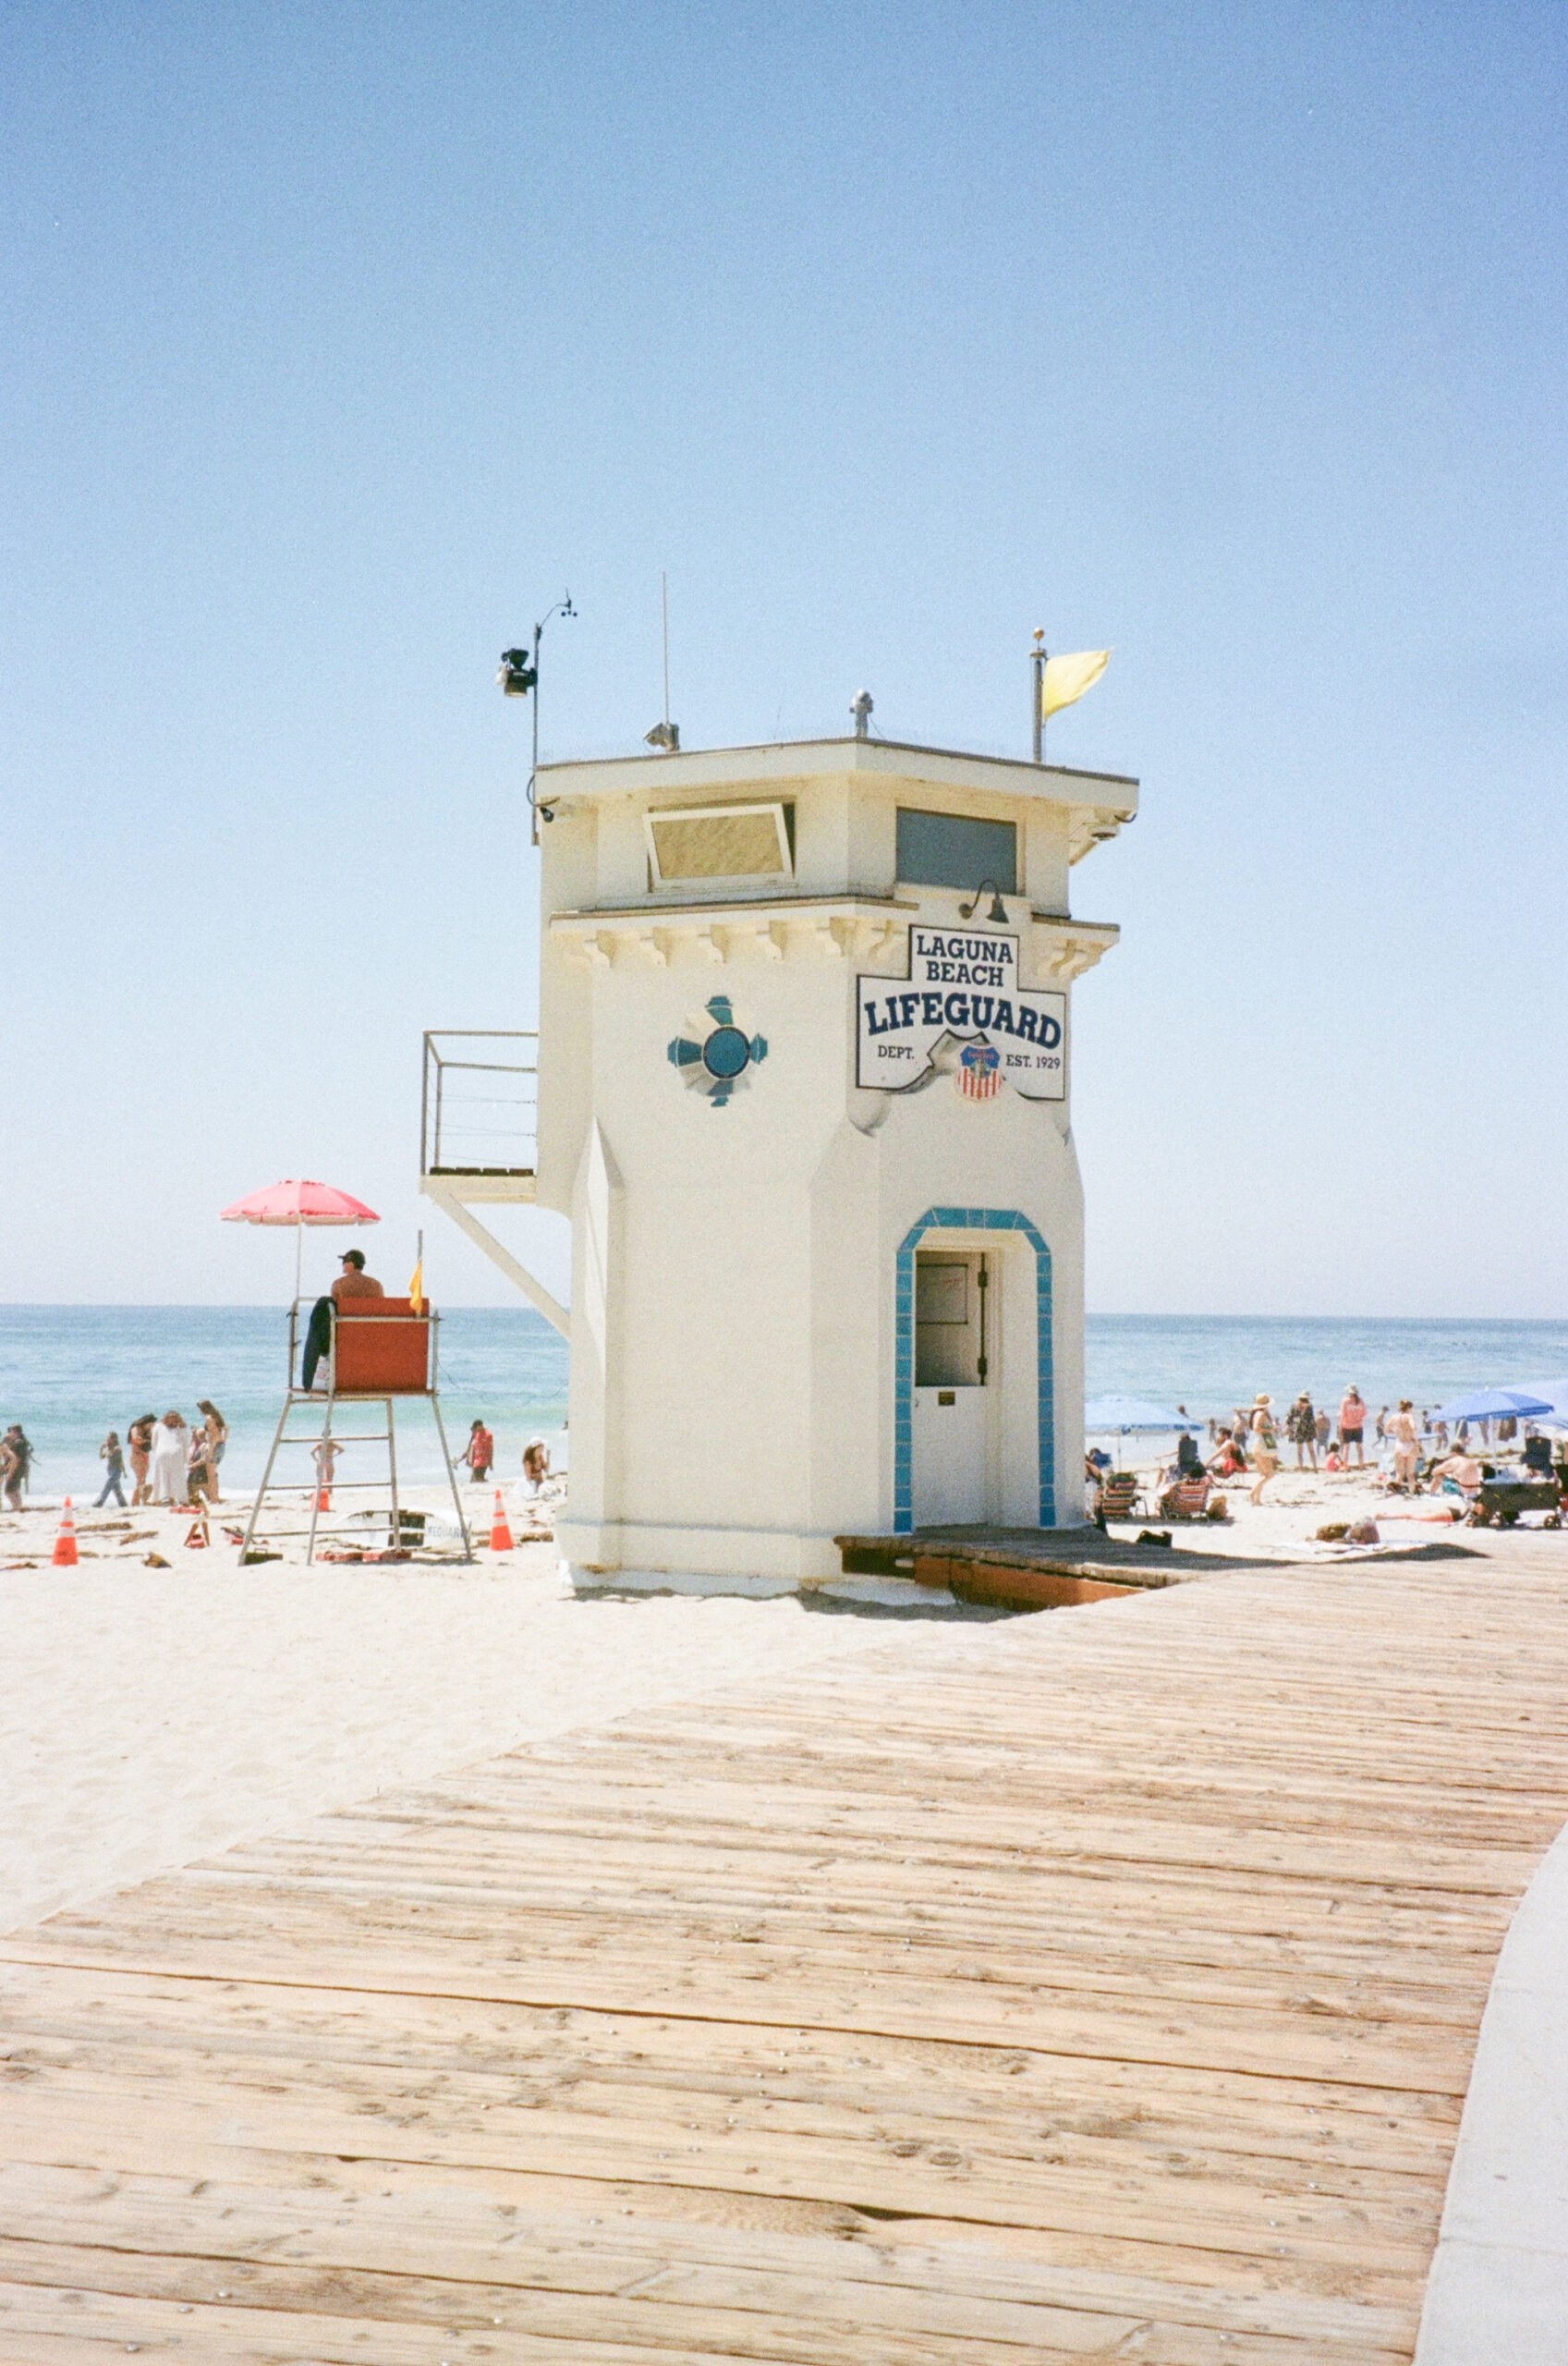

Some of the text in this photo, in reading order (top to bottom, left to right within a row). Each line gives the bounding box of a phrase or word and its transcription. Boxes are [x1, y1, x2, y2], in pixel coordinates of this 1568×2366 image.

[917, 934, 1014, 963] LAGUNA
[926, 961, 1004, 987] BEACH
[864, 992, 1062, 1050] LIFEGUARD
[878, 1044, 915, 1059] DEPT.
[1005, 1055, 1061, 1069] EST. 1929
